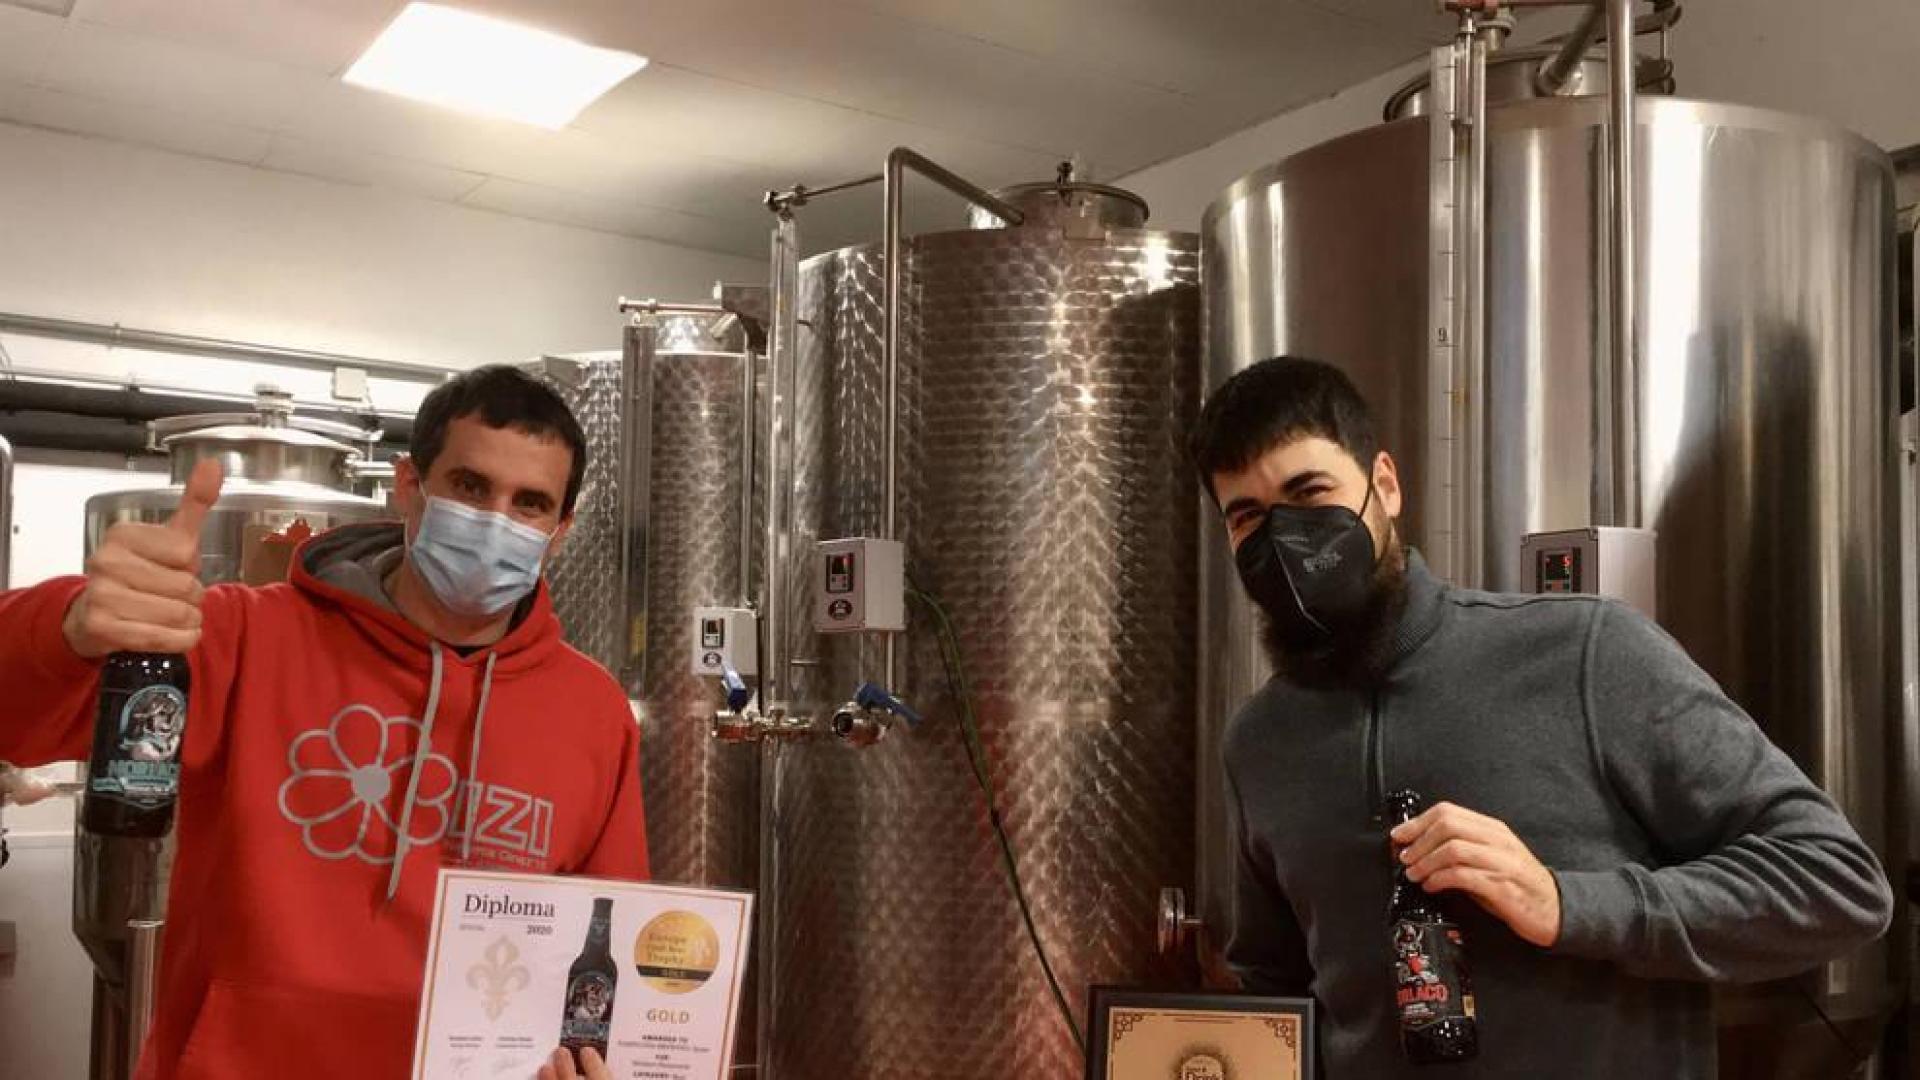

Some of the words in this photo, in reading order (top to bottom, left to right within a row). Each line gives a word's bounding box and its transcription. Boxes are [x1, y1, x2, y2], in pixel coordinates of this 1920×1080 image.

[464, 893, 555, 919] Diploma
[526, 924, 554, 936] 2020
[646, 1007, 690, 1024] GOLD
